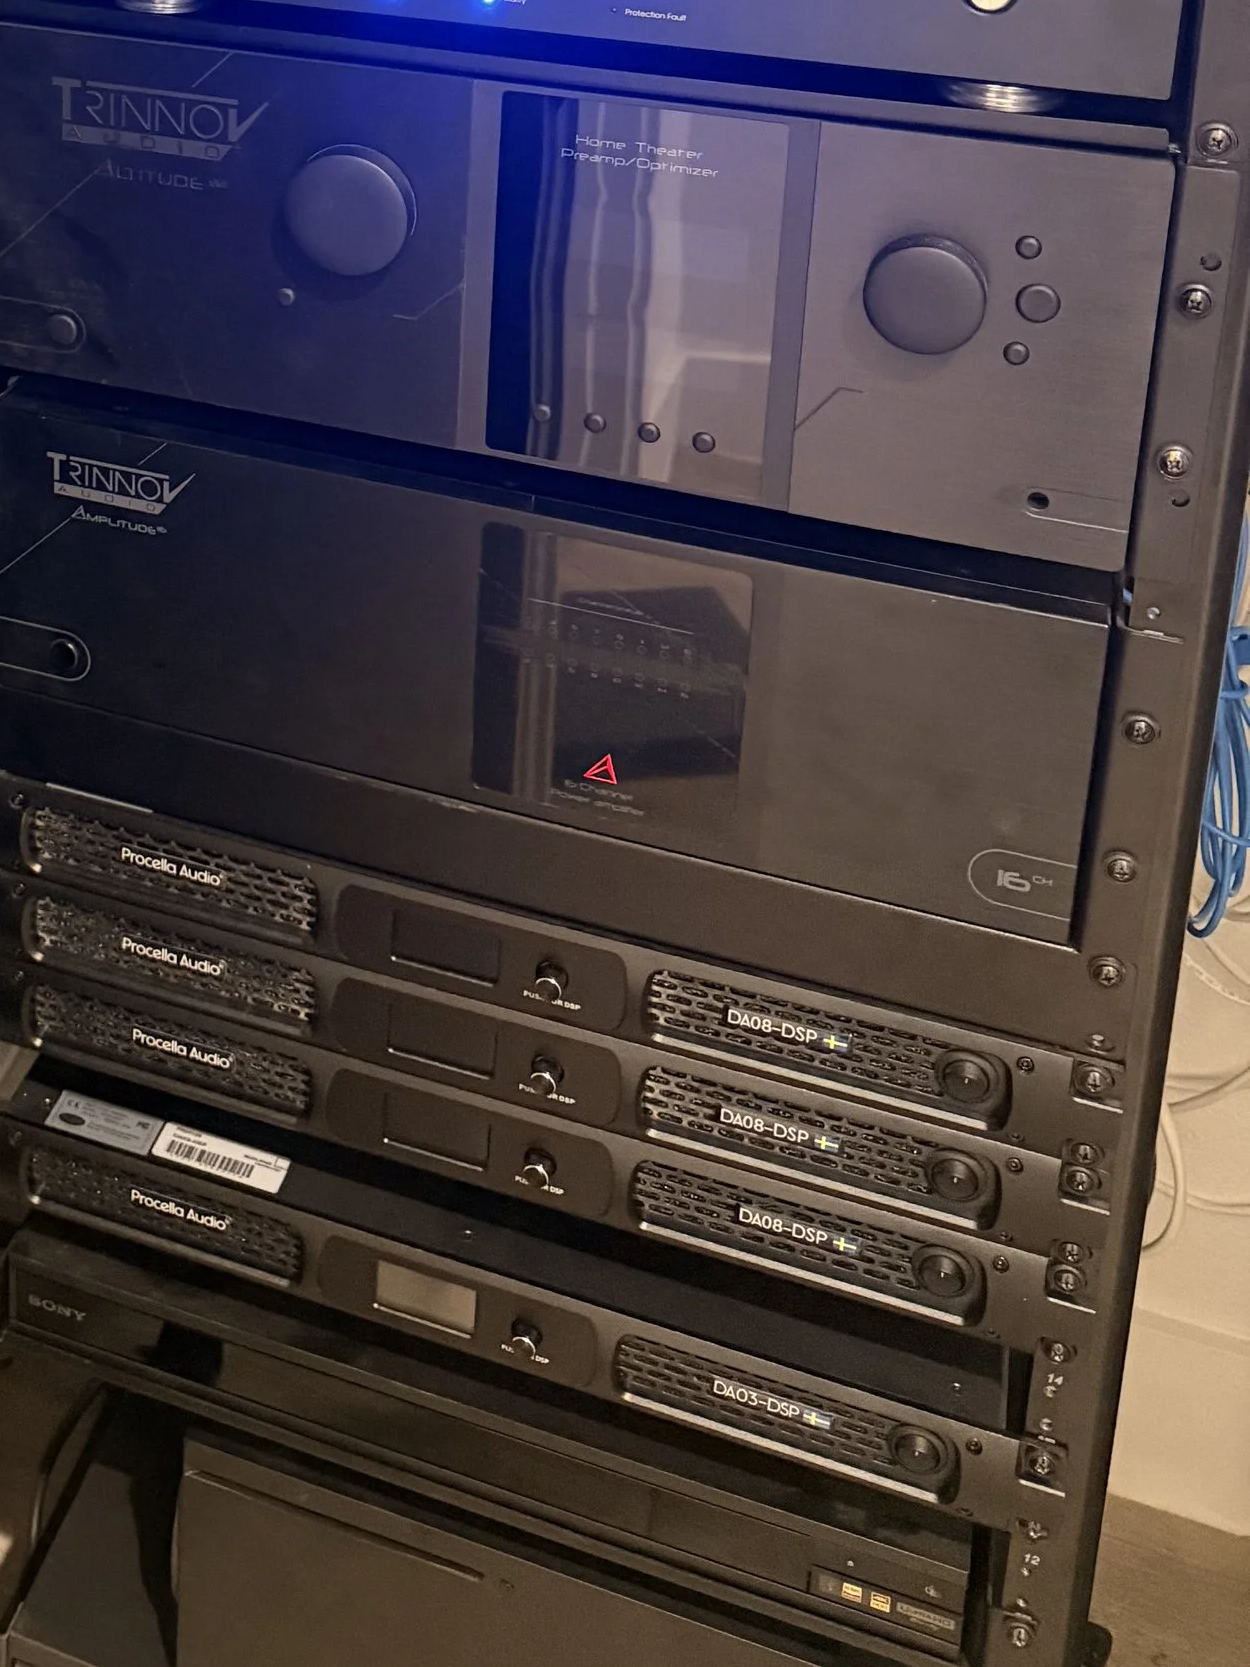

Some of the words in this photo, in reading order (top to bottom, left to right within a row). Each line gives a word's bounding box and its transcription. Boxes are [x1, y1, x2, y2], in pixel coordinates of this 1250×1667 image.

[625, 8, 666, 20] Protection
[667, 12, 687, 21] Fault
[51, 76, 270, 142] TRINNOV
[65, 126, 220, 160] AUDIO
[575, 134, 627, 150] Home
[635, 141, 703, 160] Theater
[561, 148, 719, 178] Preamp/Optimizer
[46, 451, 196, 504] TRINNOV
[58, 485, 156, 513] AUDIO
[121, 847, 177, 874] Procella
[179, 864, 221, 886] Audio
[996, 869, 1031, 892] 16
[122, 936, 178, 964] Procella
[179, 954, 221, 976] Audio
[564, 1001, 581, 1010] DSP
[727, 1009, 818, 1043] DA08-DSP
[132, 1028, 187, 1056] Procella
[189, 1047, 230, 1069] Audio
[559, 1095, 576, 1104] DSP
[720, 1108, 809, 1143] DA08-DSP
[550, 1186, 564, 1195] DSP
[131, 1189, 184, 1217] Procella
[186, 1208, 226, 1231] Audio
[739, 1207, 828, 1244] DA08-DSP
[28, 1294, 86, 1322] SONY
[535, 1355, 550, 1364] DSP
[1047, 1373, 1064, 1385] 14
[713, 1380, 800, 1418] DA03-DSP
[1024, 1553, 1041, 1566] 12
